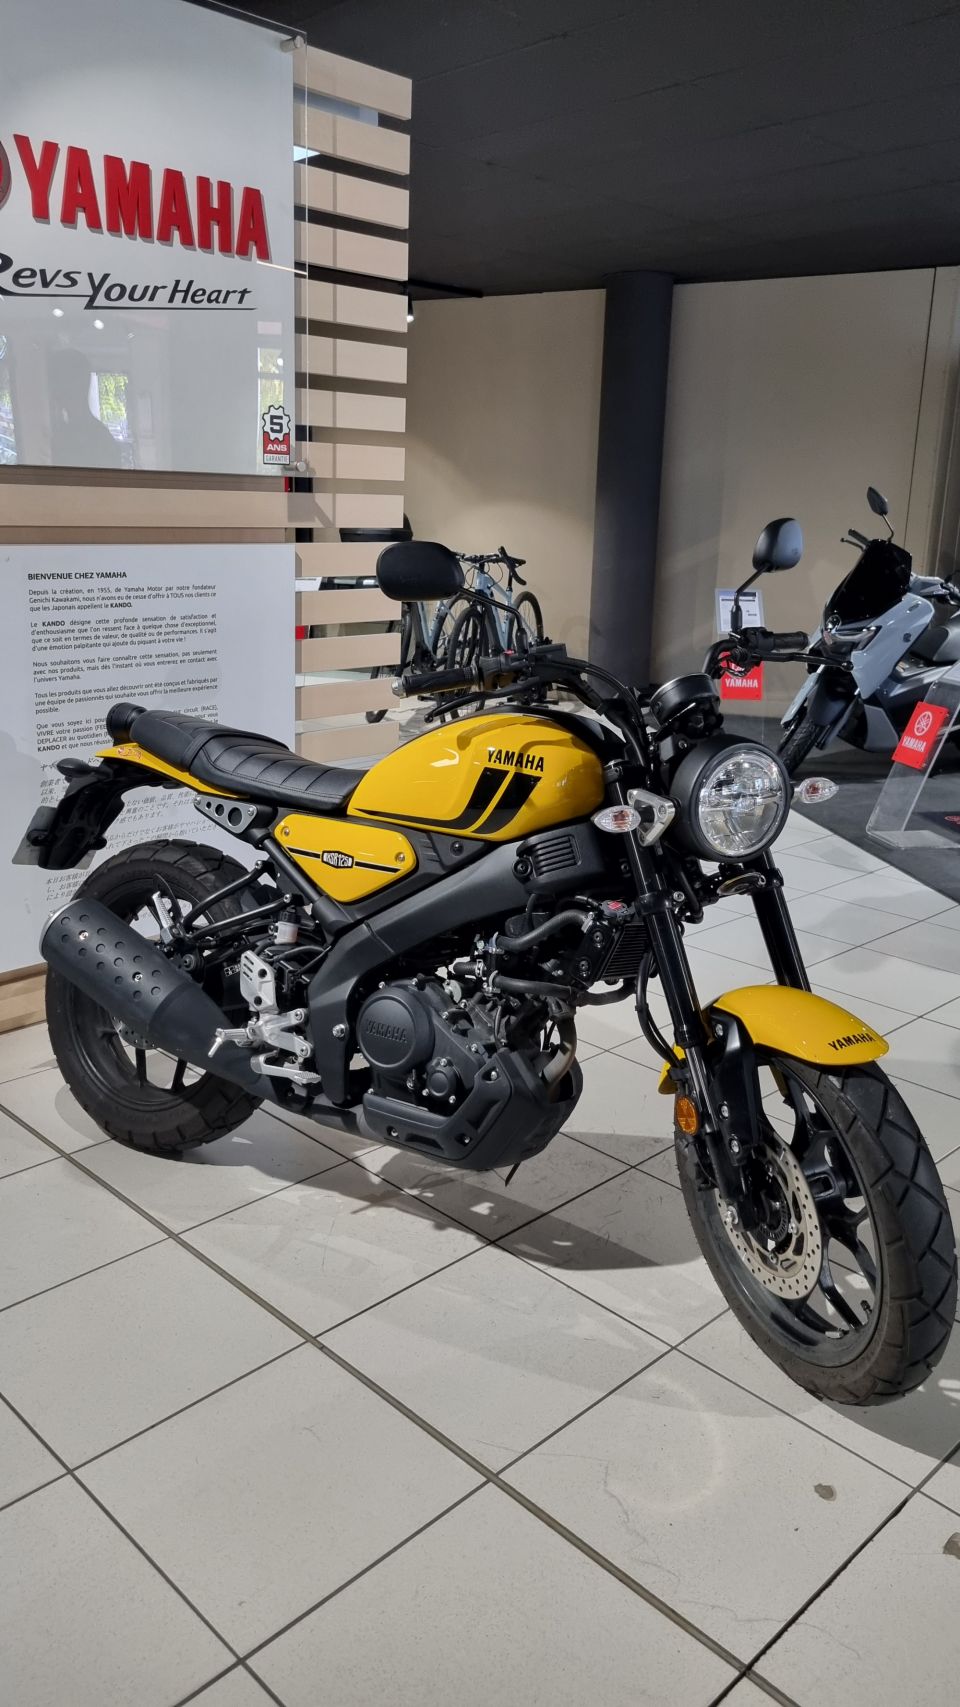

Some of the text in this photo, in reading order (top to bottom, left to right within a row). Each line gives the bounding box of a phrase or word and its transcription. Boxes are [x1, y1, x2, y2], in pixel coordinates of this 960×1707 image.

[13, 134, 271, 262] YAMAHA
[84, 272, 168, 310] Your
[168, 279, 252, 304] Heart
[270, 415, 284, 434] 5
[266, 444, 288, 452] ANS
[27, 572, 73, 580] BIENVENUE
[28, 596, 50, 604] Genichi
[113, 616, 138, 624] profonde
[73, 642, 101, 650] palpitante
[136, 638, 157, 646] piquant
[725, 679, 759, 688] YAMAHA
[57, 689, 81, 697] produits
[902, 736, 927, 753] YAMAHA
[488, 749, 545, 773] YAMAHA
[366, 1019, 408, 1044] YAMAHA
[828, 1033, 877, 1051] YAMAHA
